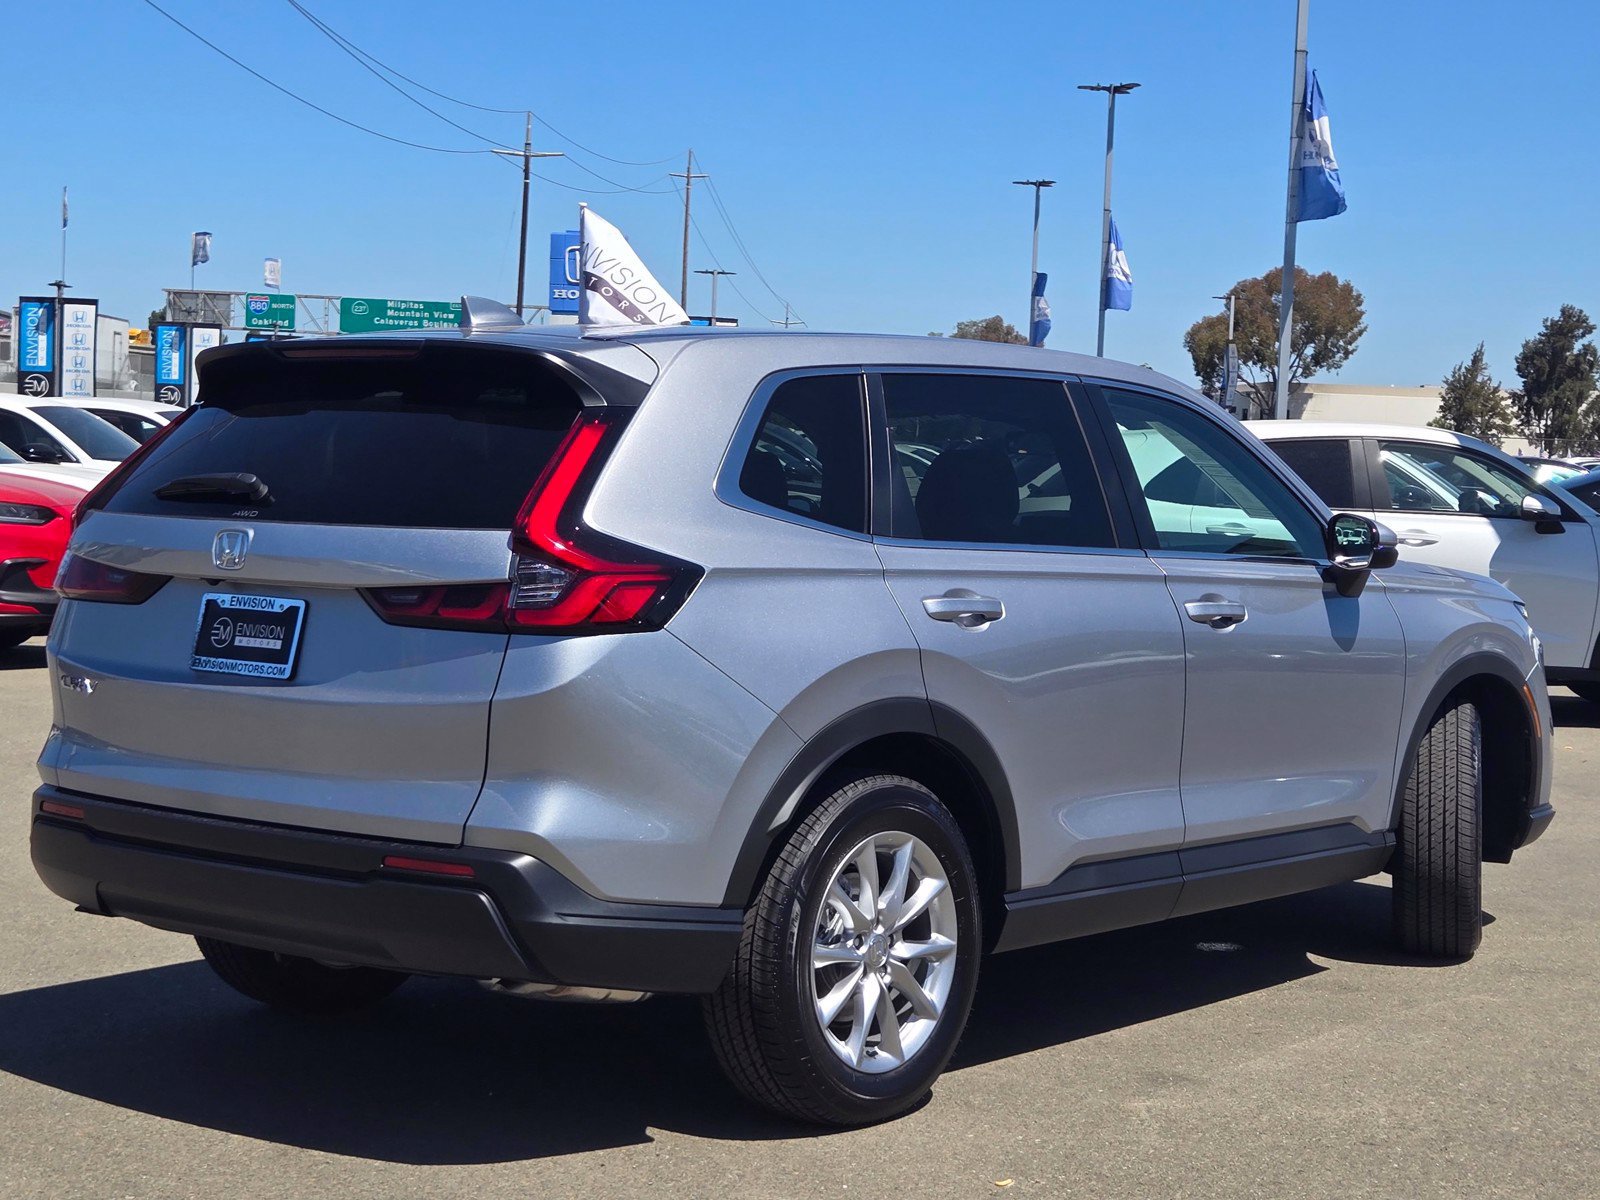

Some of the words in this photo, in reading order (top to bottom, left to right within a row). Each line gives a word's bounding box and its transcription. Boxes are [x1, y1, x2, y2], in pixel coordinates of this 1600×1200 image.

[250, 301, 268, 310] 880
[387, 300, 424, 309] Milpitas
[387, 309, 430, 318] Mountain
[433, 311, 455, 319] View
[251, 317, 289, 327] Oakland
[374, 317, 419, 327] Calaveras
[25, 307, 39, 367] ENVISION
[161, 330, 173, 380] ENVISION
[229, 596, 276, 610] ENVISION
[235, 622, 286, 639] ENVISION
[239, 640, 277, 648] MOTORS
[192, 657, 287, 676] ENVISIONMOTORS.COM
